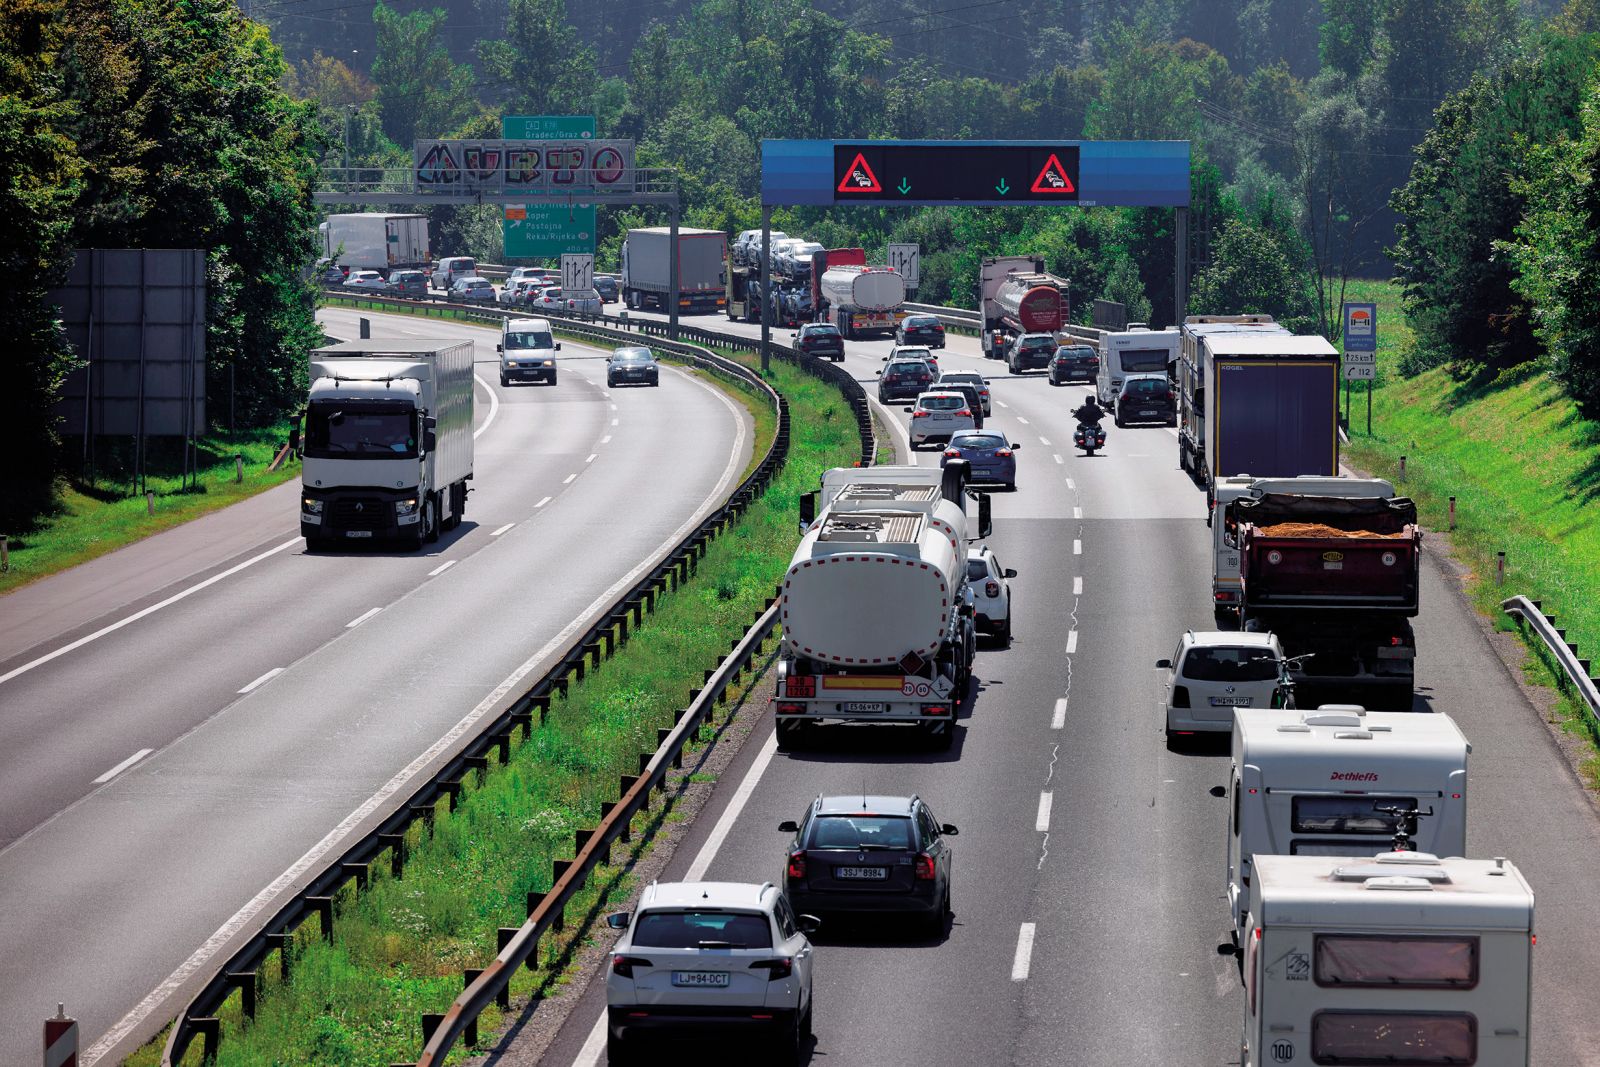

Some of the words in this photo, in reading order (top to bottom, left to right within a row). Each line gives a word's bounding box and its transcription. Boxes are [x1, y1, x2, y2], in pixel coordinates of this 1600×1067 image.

[525, 130, 578, 139] Gradec/Graz
[526, 212, 549, 220] Koper
[526, 222, 562, 231] Postojna
[526, 232, 576, 241] Reka/Rijeka
[1358, 368, 1371, 376] 112
[788, 687, 810, 697] 1202
[918, 686, 928, 694] 80
[1330, 771, 1379, 782] Dethleffs
[1273, 1044, 1292, 1060] 100
